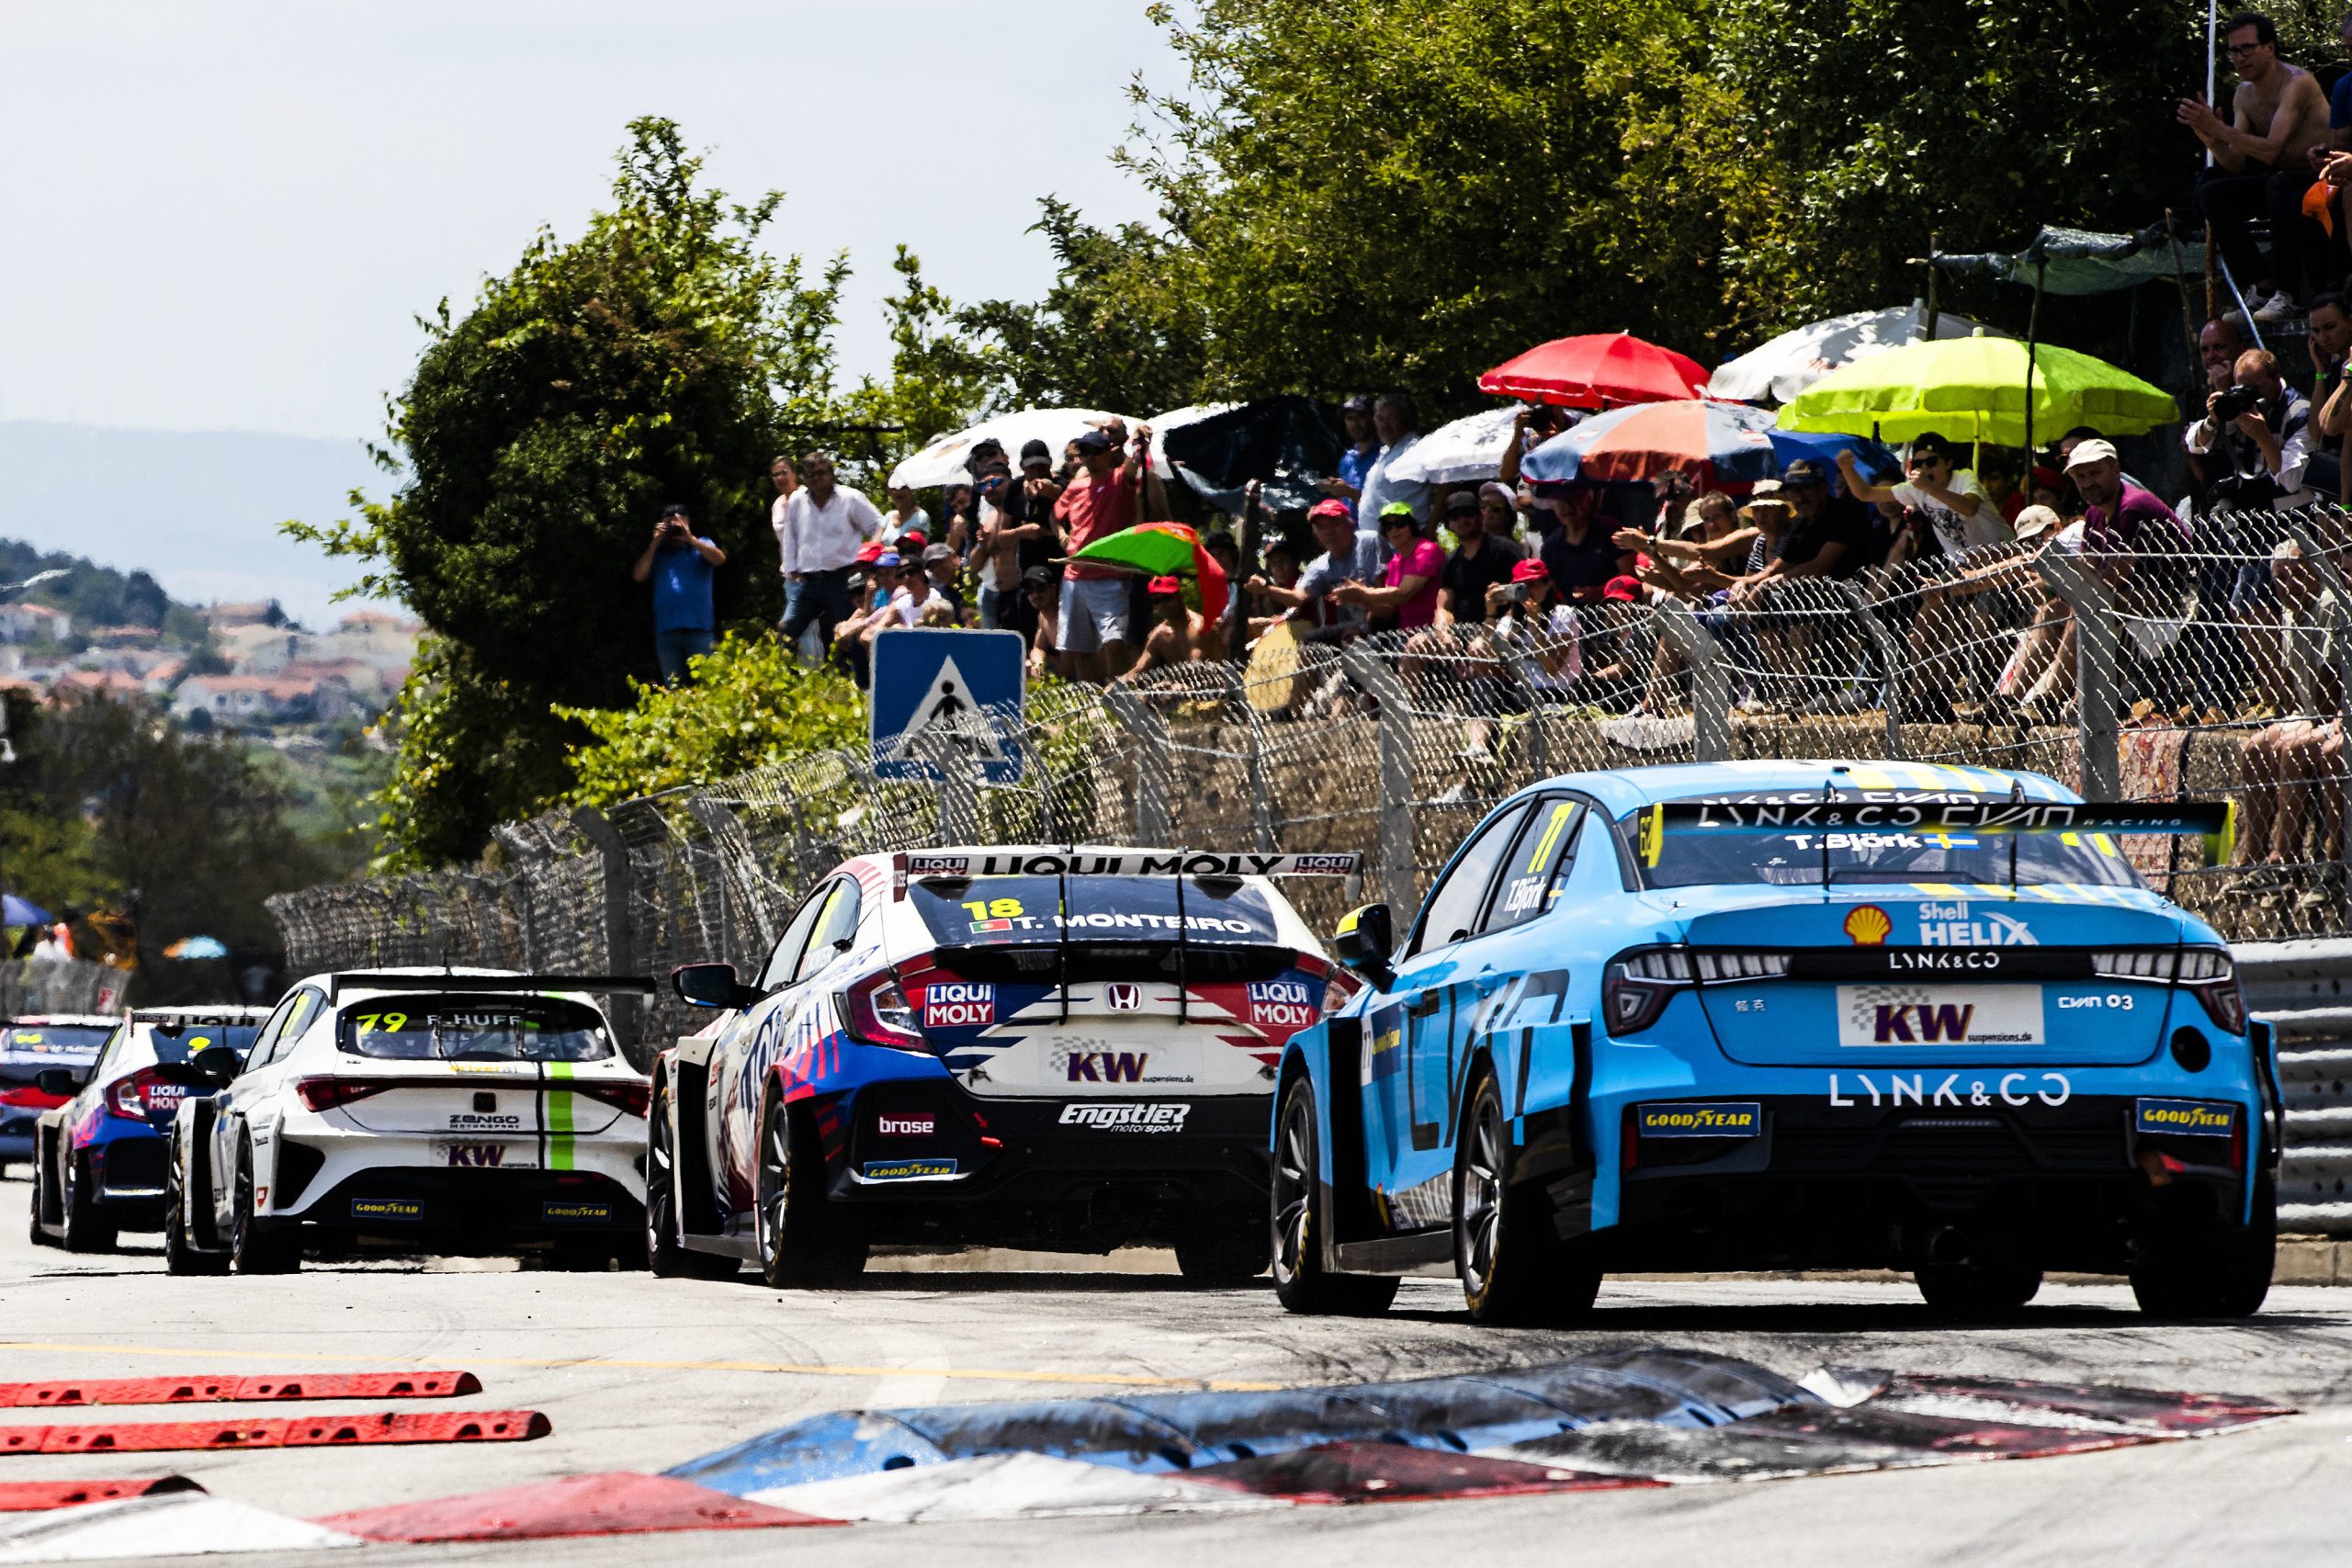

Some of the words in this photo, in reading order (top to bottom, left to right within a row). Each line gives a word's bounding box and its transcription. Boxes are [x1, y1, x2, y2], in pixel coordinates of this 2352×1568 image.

[2083, 818, 2182, 827] RACING
[915, 857, 968, 869] LIQUI
[982, 856, 1123, 874] LIQUI
[1139, 855, 1284, 874] MOLY
[1298, 857, 1352, 868] LIQUI
[961, 898, 1024, 920] 18
[1918, 901, 1969, 920] Shell
[1057, 914, 1252, 933] MONTEIRO
[1919, 915, 2041, 946] HELIX
[930, 985, 991, 1003] LIQUI
[1251, 984, 1307, 1003] LIQUI
[929, 1004, 991, 1024] MOLY
[1253, 1004, 1308, 1024] MOLY
[1874, 1004, 1974, 1043] KW
[356, 1012, 408, 1037] 79
[1068, 1053, 1148, 1082] KW
[151, 1086, 186, 1096] LIQUI
[1829, 1073, 2071, 1107] LYNK&CO
[879, 1116, 933, 1134] brose
[1058, 1104, 1191, 1129] Engstler
[1645, 1111, 1752, 1129] GOODYEAR
[2144, 1107, 2231, 1127] GOODYEAR
[1111, 1123, 1183, 1134] motorsport
[448, 1145, 506, 1167] KW
[870, 1164, 951, 1178] GOODYEAR
[356, 1202, 419, 1214] GOODYEAR
